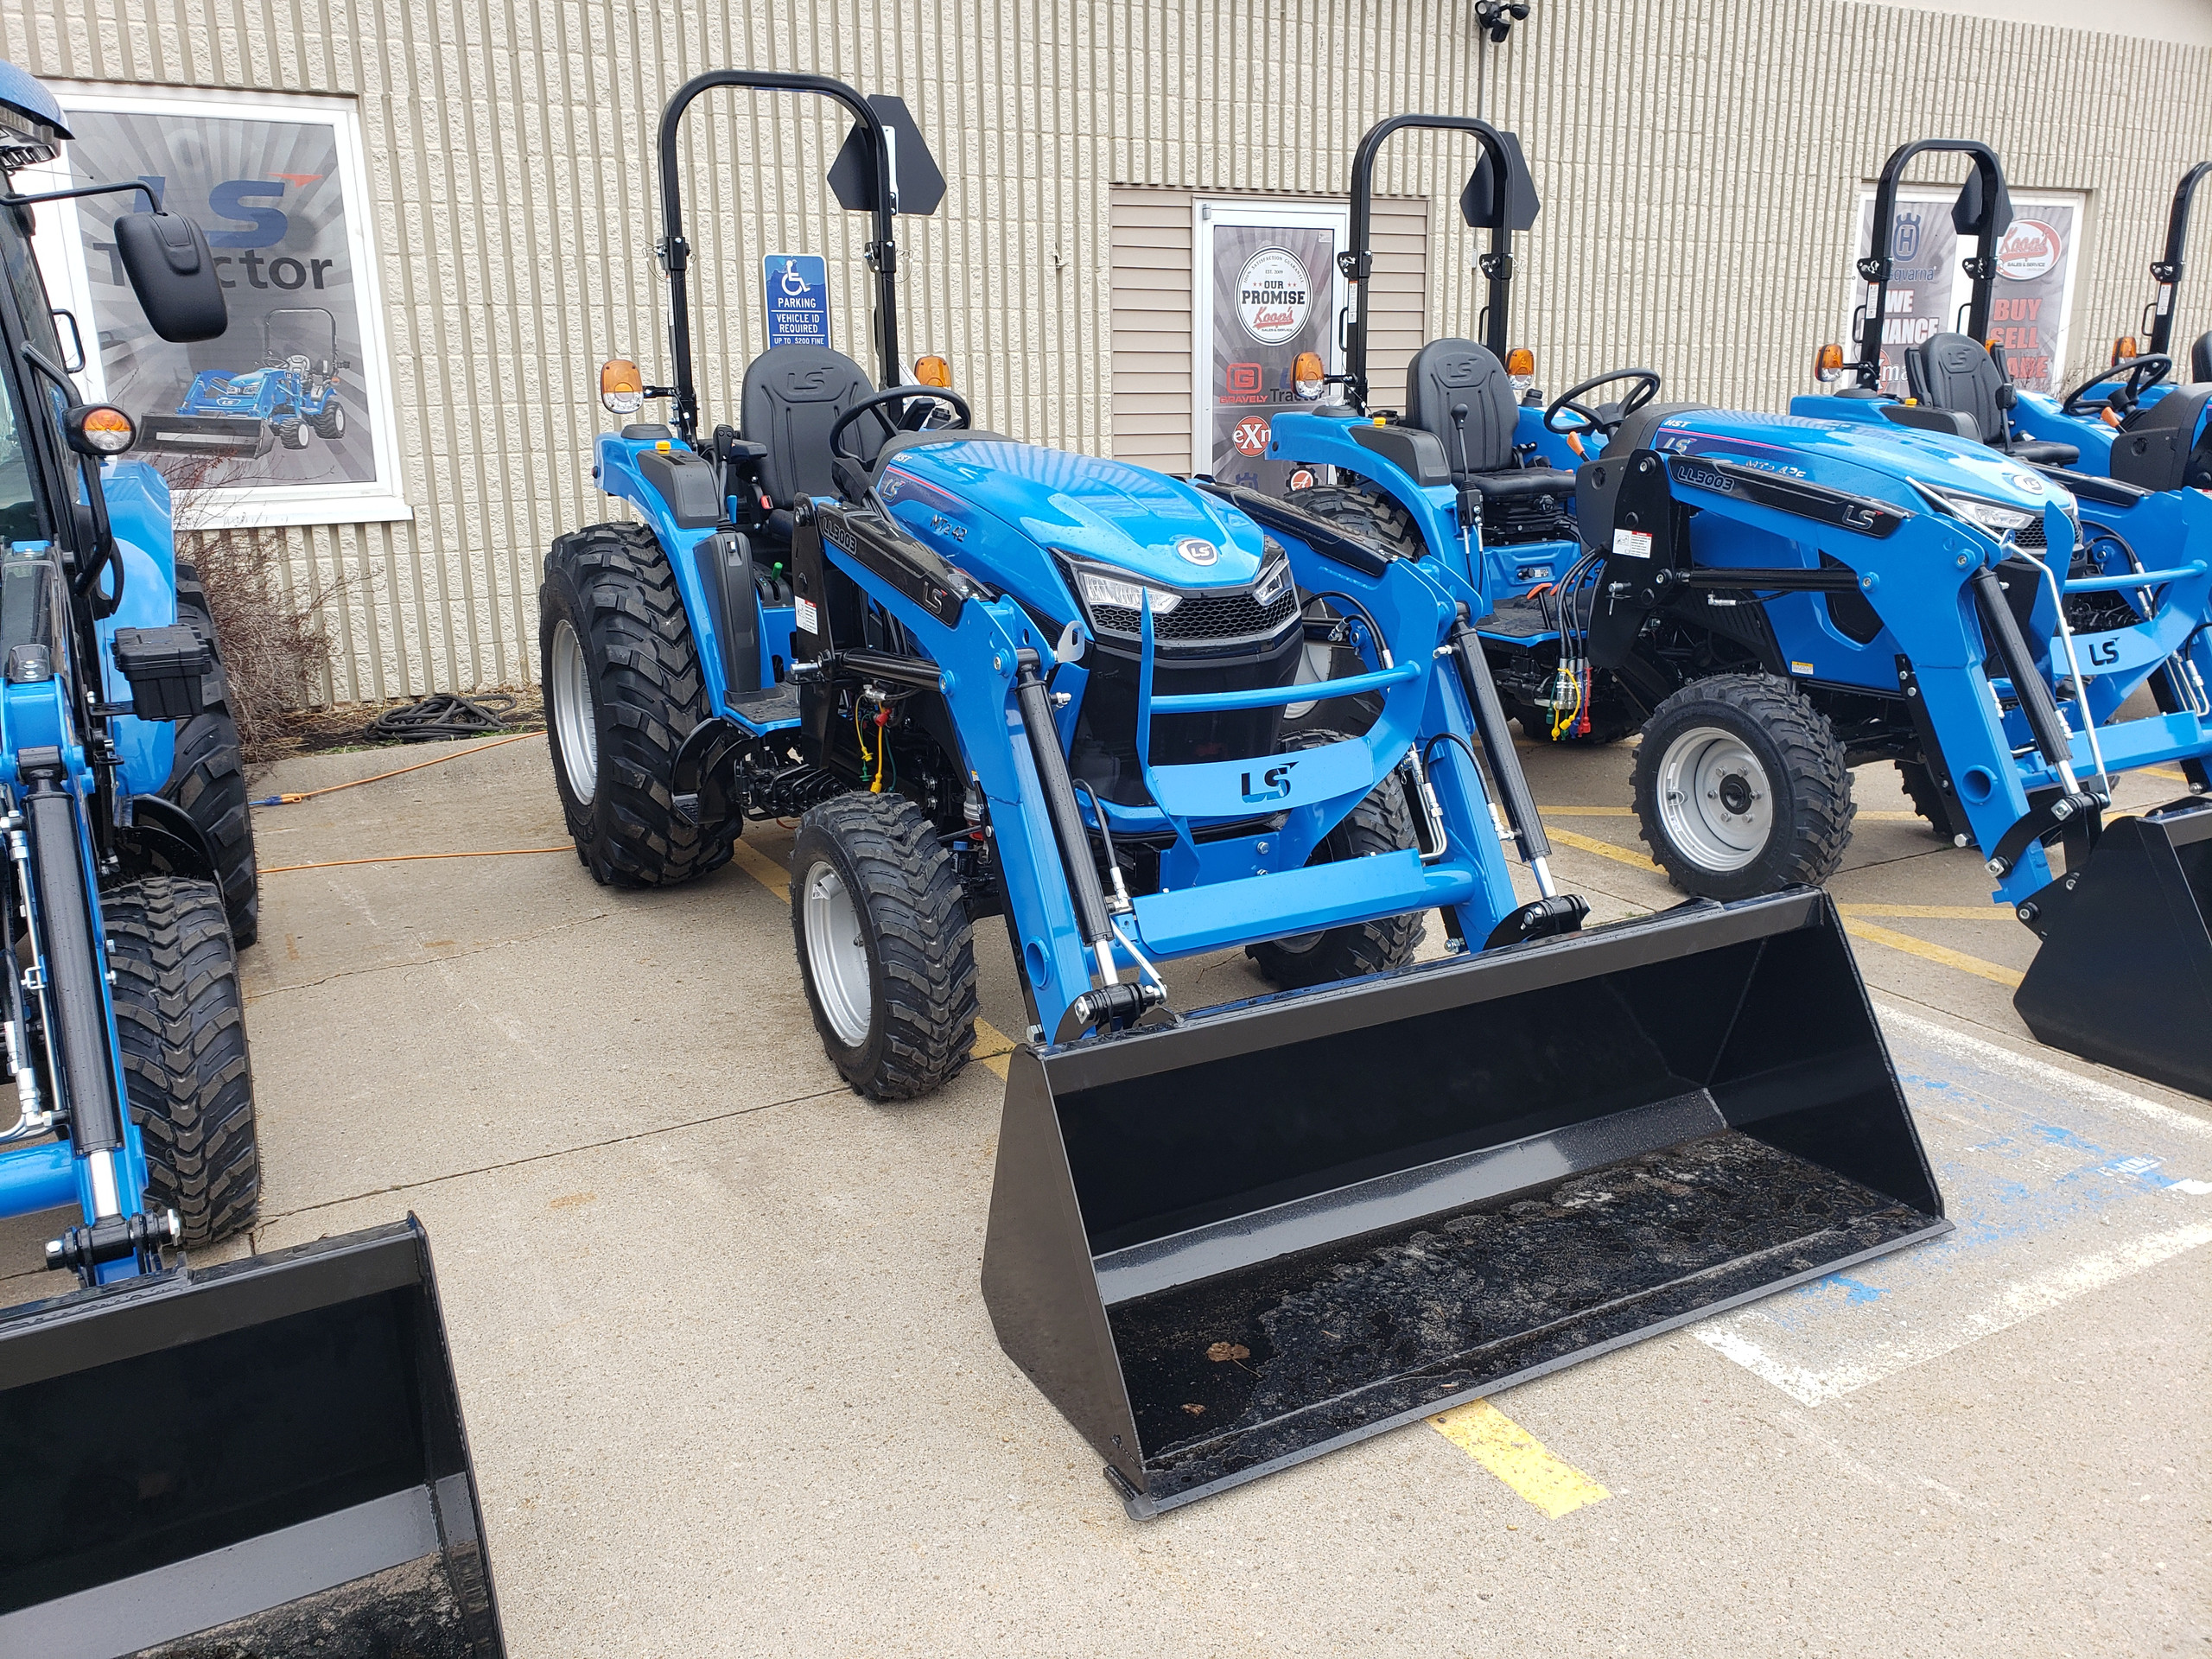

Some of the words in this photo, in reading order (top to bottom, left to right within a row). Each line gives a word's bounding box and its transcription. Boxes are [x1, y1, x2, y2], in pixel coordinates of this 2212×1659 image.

[93, 243, 333, 289] Tctor
[1890, 267, 1934, 283] qvarna
[778, 298, 817, 308] PARKING
[1242, 290, 1306, 304] PROMISE
[1885, 289, 1914, 313] WE
[777, 314, 809, 322] VEHICLE
[812, 315, 820, 323] ID
[1993, 298, 2043, 321] BUY
[779, 324, 818, 333] REQUIRED
[1990, 327, 2039, 349] SELL
[787, 370, 827, 395] LS
[1220, 395, 1268, 404] GRAVELY
[1663, 419, 1692, 428] HST
[1677, 466, 1735, 493] LL3003
[1842, 505, 1878, 529] LS
[823, 517, 857, 555] LL3003
[1191, 546, 1211, 558] LS
[924, 582, 944, 613] LS
[2088, 639, 2120, 666] LS
[1241, 766, 1294, 803] LS
